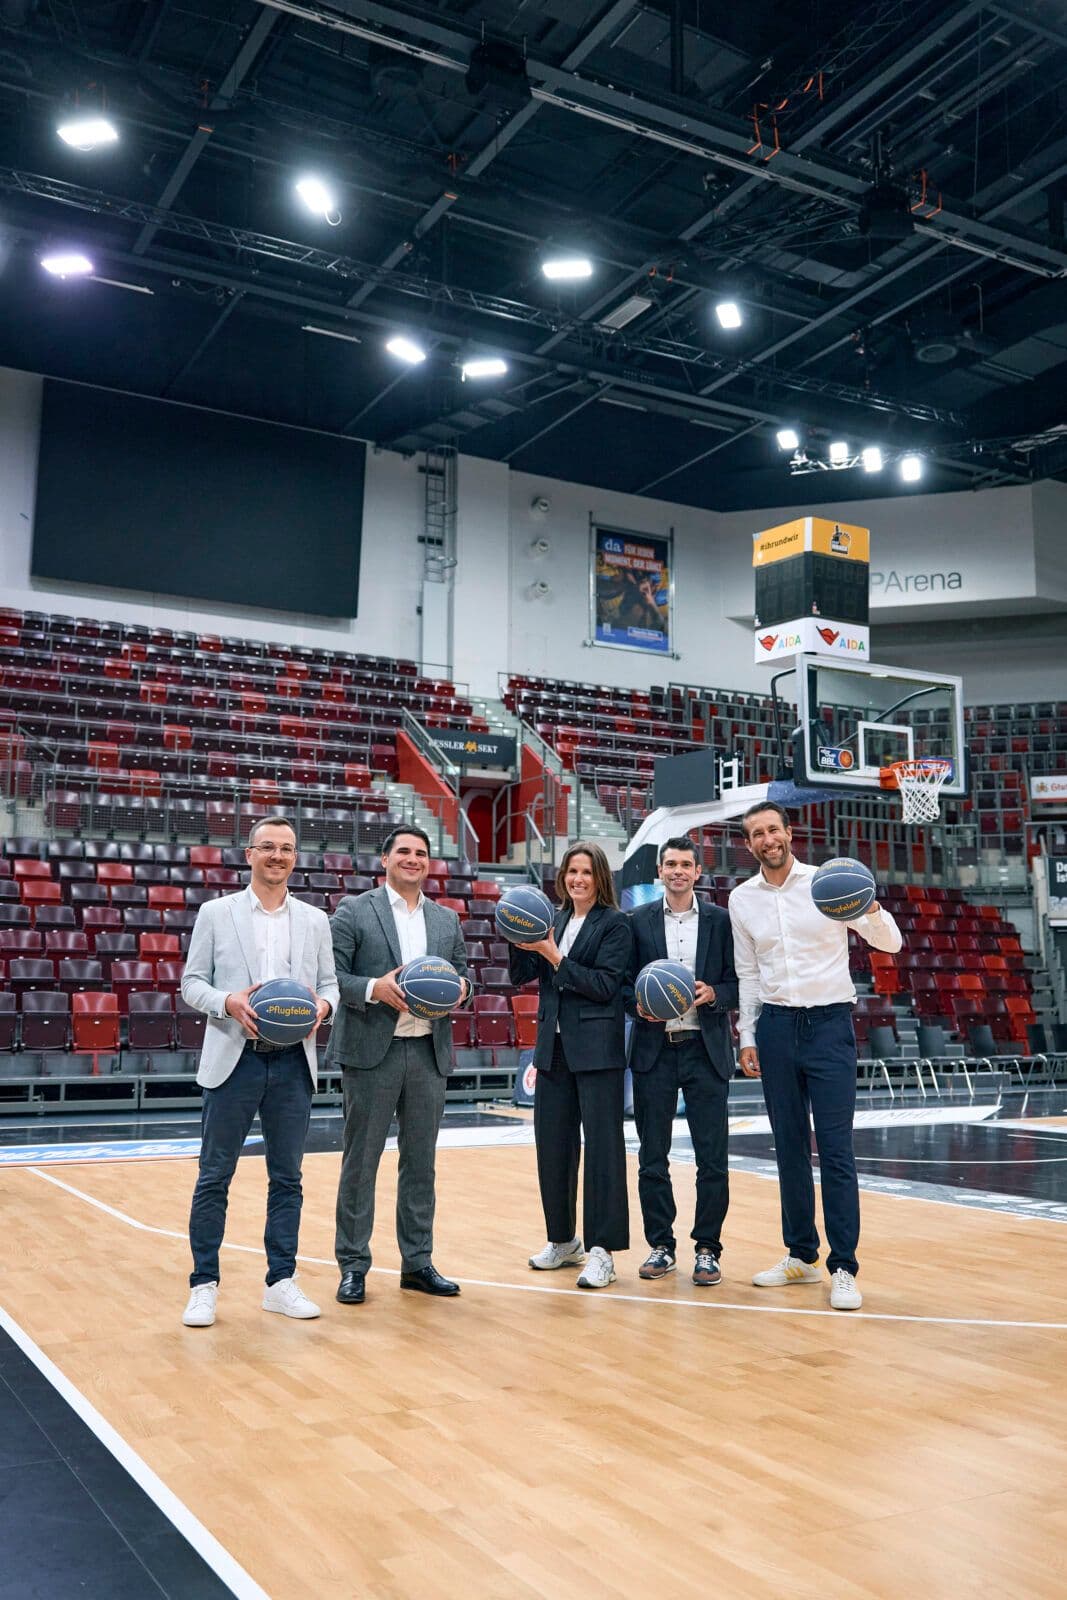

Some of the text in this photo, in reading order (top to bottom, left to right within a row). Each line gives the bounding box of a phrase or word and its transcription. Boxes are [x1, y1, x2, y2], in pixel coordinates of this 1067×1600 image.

[604, 538, 622, 553] da
[760, 533, 799, 551] #ihrundwir
[870, 570, 962, 593] PArena
[778, 634, 802, 649] AIDA
[839, 637, 865, 652] AIDA
[478, 744, 498, 754] SEKT
[268, 1005, 312, 1017] Pflugfelder
